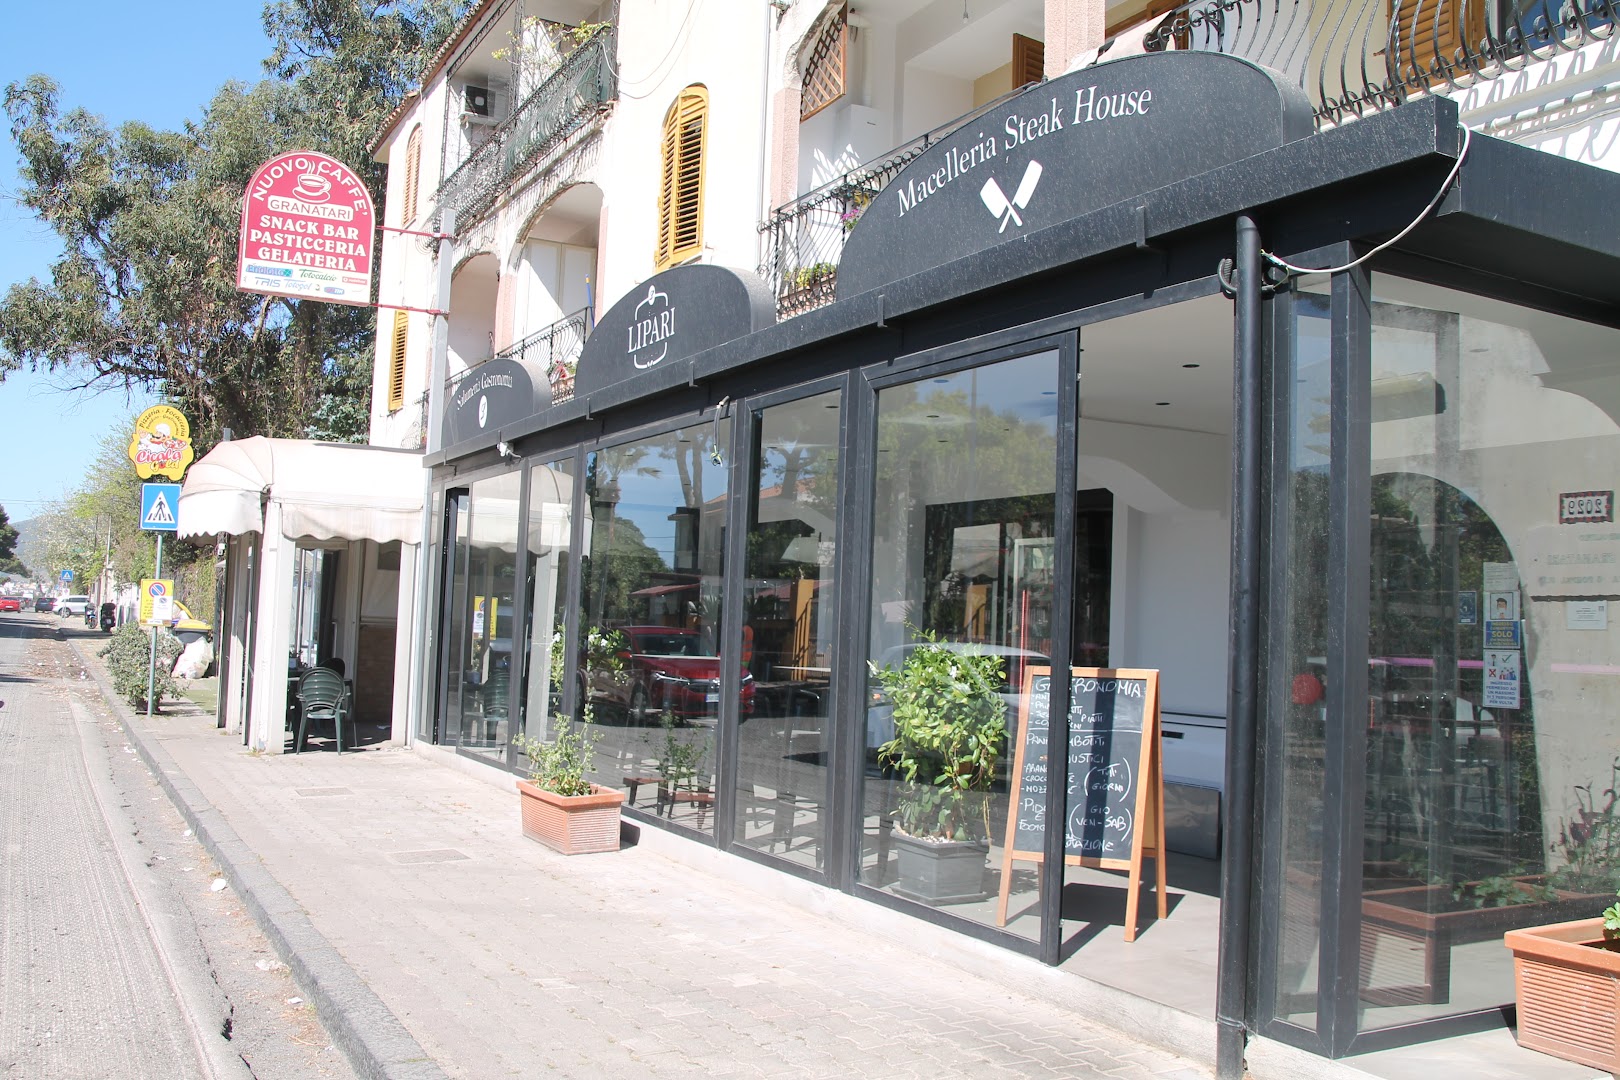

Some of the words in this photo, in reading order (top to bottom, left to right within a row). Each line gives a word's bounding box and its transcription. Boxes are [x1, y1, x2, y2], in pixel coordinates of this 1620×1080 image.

[897, 133, 997, 217] Macelleria
[1005, 98, 1064, 151] Steak
[1072, 85, 1152, 125] House
[253, 158, 308, 201] NUOVO
[319, 161, 368, 216] CAFFE'
[270, 200, 351, 219] GRANATARI
[260, 215, 319, 235] SNACK
[323, 224, 359, 240] BAR
[250, 229, 366, 256] PASTICCERIA
[258, 246, 356, 271] GELATERIA
[299, 269, 337, 281] Totocalcio
[628, 307, 675, 353] LIPARI
[139, 409, 160, 428] Pizzeria
[137, 448, 181, 462] Cicala
[1104, 816, 1127, 831] SAB
